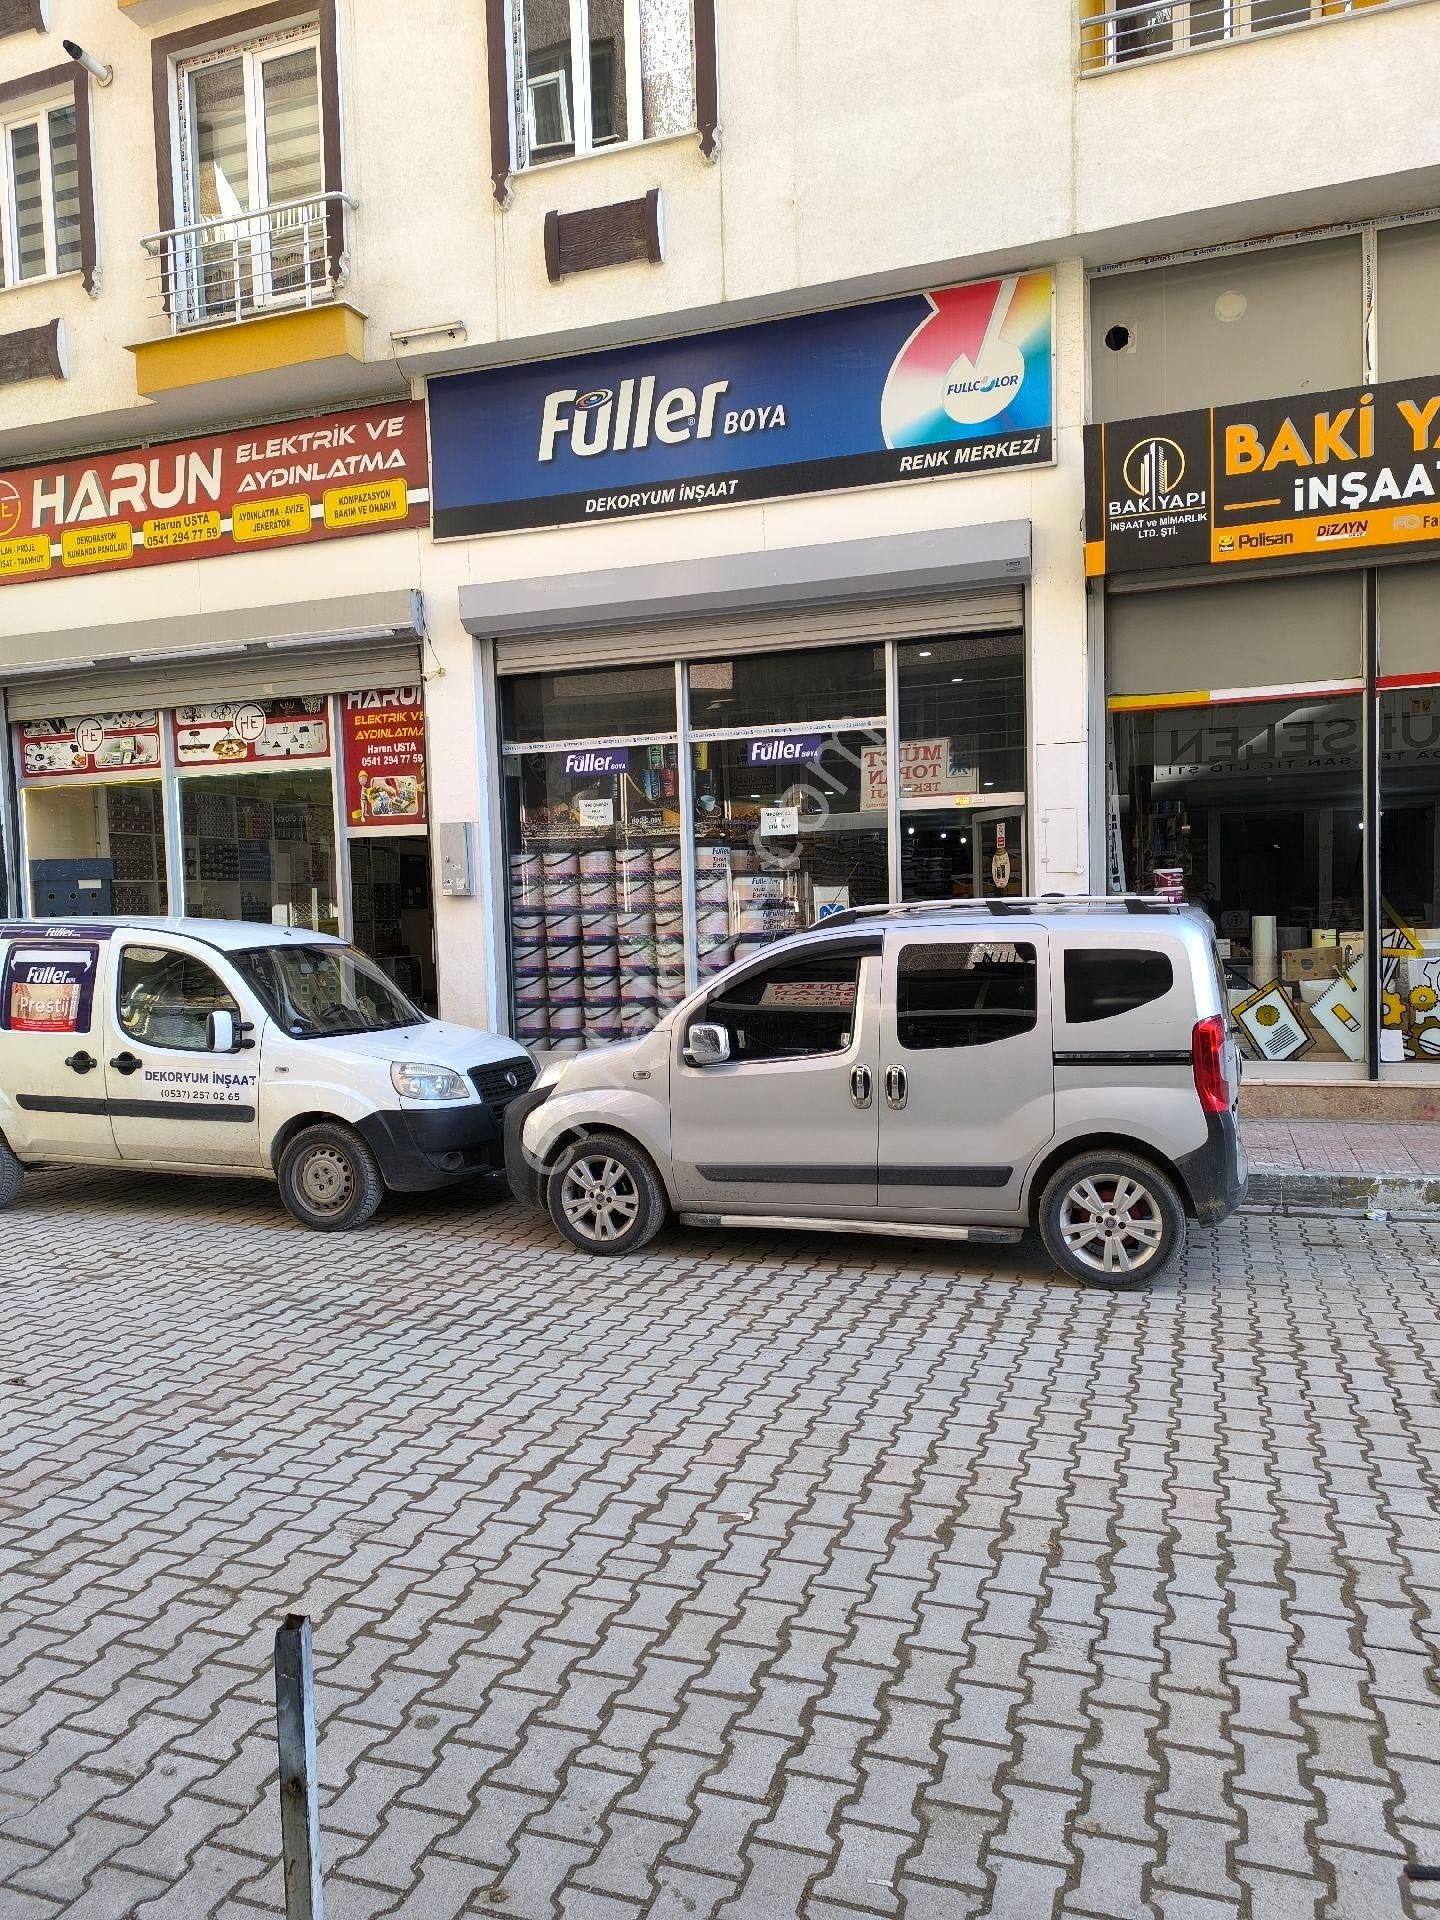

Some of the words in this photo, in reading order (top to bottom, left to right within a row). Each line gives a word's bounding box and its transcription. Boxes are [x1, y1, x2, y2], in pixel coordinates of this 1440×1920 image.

[723, 404, 786, 435] BOYA
[236, 423, 357, 464] ELEKTRİK
[365, 416, 405, 441] VE
[1225, 392, 1375, 476] BAKİ
[1396, 395, 1440, 452] Y
[899, 449, 950, 472] RENK
[953, 433, 1041, 464] MERKEZİ
[237, 448, 407, 493] AYDINLATMA
[32, 447, 223, 529] HARUN
[585, 488, 675, 513] DEKORYUM
[679, 479, 739, 503] İNŞAAT
[1294, 461, 1440, 512] İNŞAA
[338, 489, 391, 506] KOMPAZASYON
[238, 508, 279, 522] AYDINLATMA
[284, 502, 304, 515] AVİZE
[334, 506, 356, 519] BAKIM
[358, 503, 367, 516] VE
[368, 501, 397, 514] ONARIM
[153, 519, 182, 532] Harun
[184, 513, 210, 527] USTA
[1110, 520, 1144, 532] İNŞAAT
[1146, 519, 1157, 527] ve
[1159, 512, 1208, 526] MİMARLIK
[76, 531, 117, 545] DEKORASYON
[147, 535, 169, 547] 0541
[172, 531, 189, 544] 294
[192, 529, 203, 540] 77
[206, 526, 218, 538] 59
[1138, 528, 1159, 539] LTD.
[1160, 526, 1178, 538] ŞTİ.
[1238, 532, 1294, 549] Polisan
[17, 544, 36, 553] PROJE
[67, 546, 97, 559] KUMANDA
[98, 542, 128, 556] PANOLARI
[347, 686, 422, 710] HARU
[354, 711, 407, 726] ELEKTRİK
[367, 744, 392, 754] Harun
[393, 741, 416, 752] USTA
[361, 757, 380, 767] 0541
[383, 755, 398, 765] 294
[400, 754, 410, 764] 77
[413, 753, 424, 763] 59
[20, 996, 70, 1017] Prestij
[145, 1070, 209, 1084] DEKORYUM
[212, 1071, 257, 1088] İNŞAAT
[160, 1089, 190, 1099] (0537)
[193, 1091, 210, 1099] 257
[212, 1092, 225, 1100] 02
[227, 1092, 240, 1101] 65
